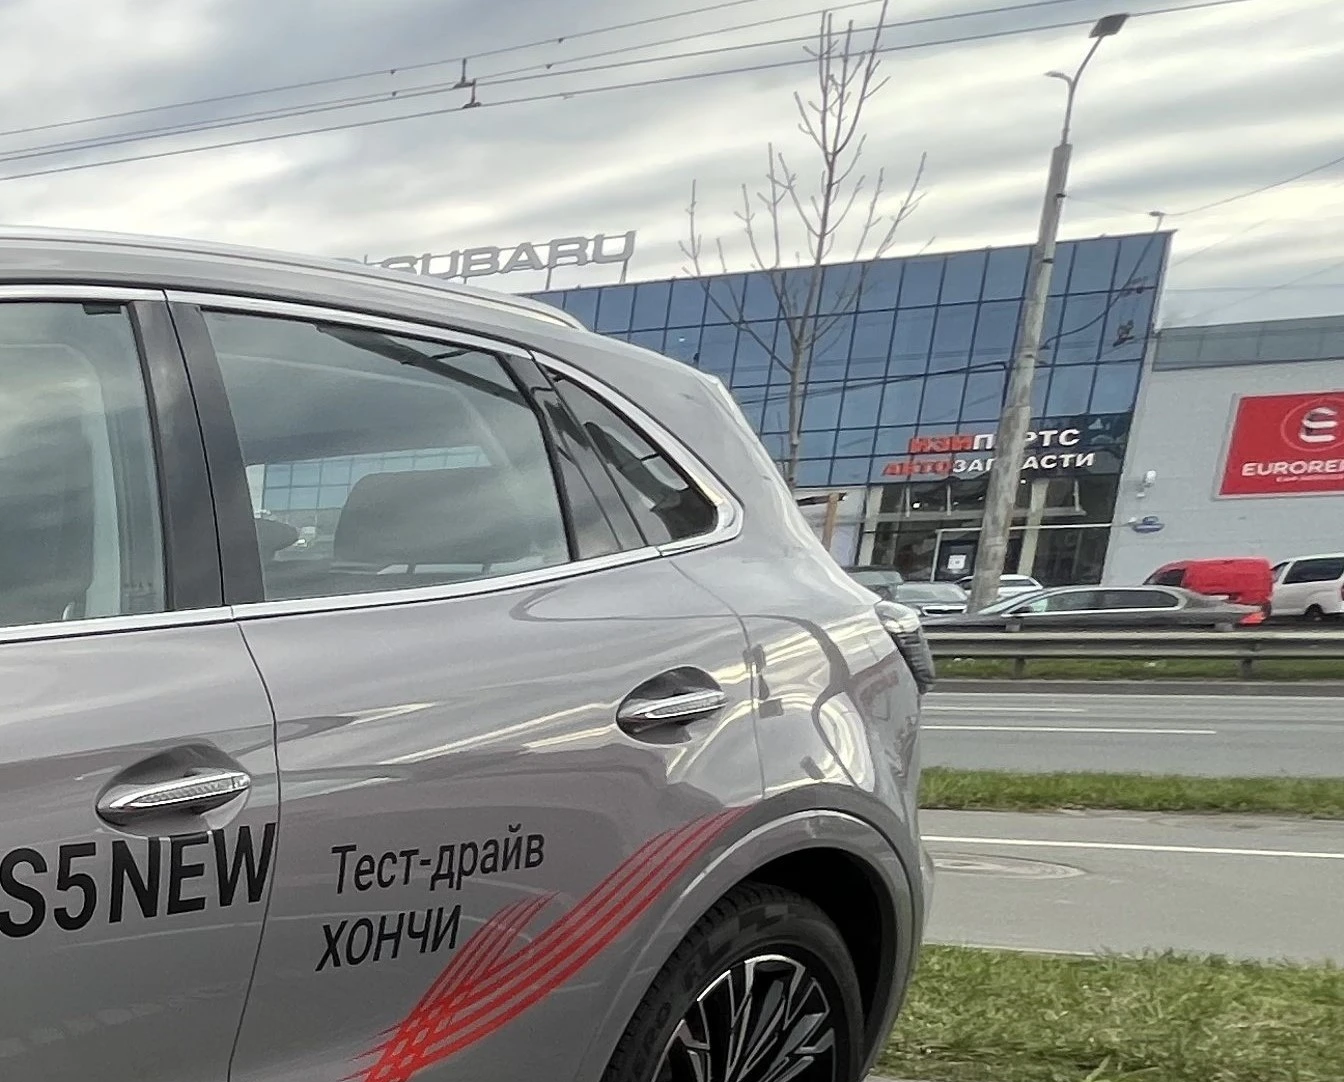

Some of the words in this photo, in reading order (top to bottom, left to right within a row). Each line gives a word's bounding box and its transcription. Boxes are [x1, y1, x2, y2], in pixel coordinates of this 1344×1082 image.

[380, 230, 637, 279] SUBARU
[882, 452, 1096, 476] АВТОЗАПАСТИ
[330, 823, 546, 895] Тест-драйв
[314, 904, 462, 972] ХОНЧИ
